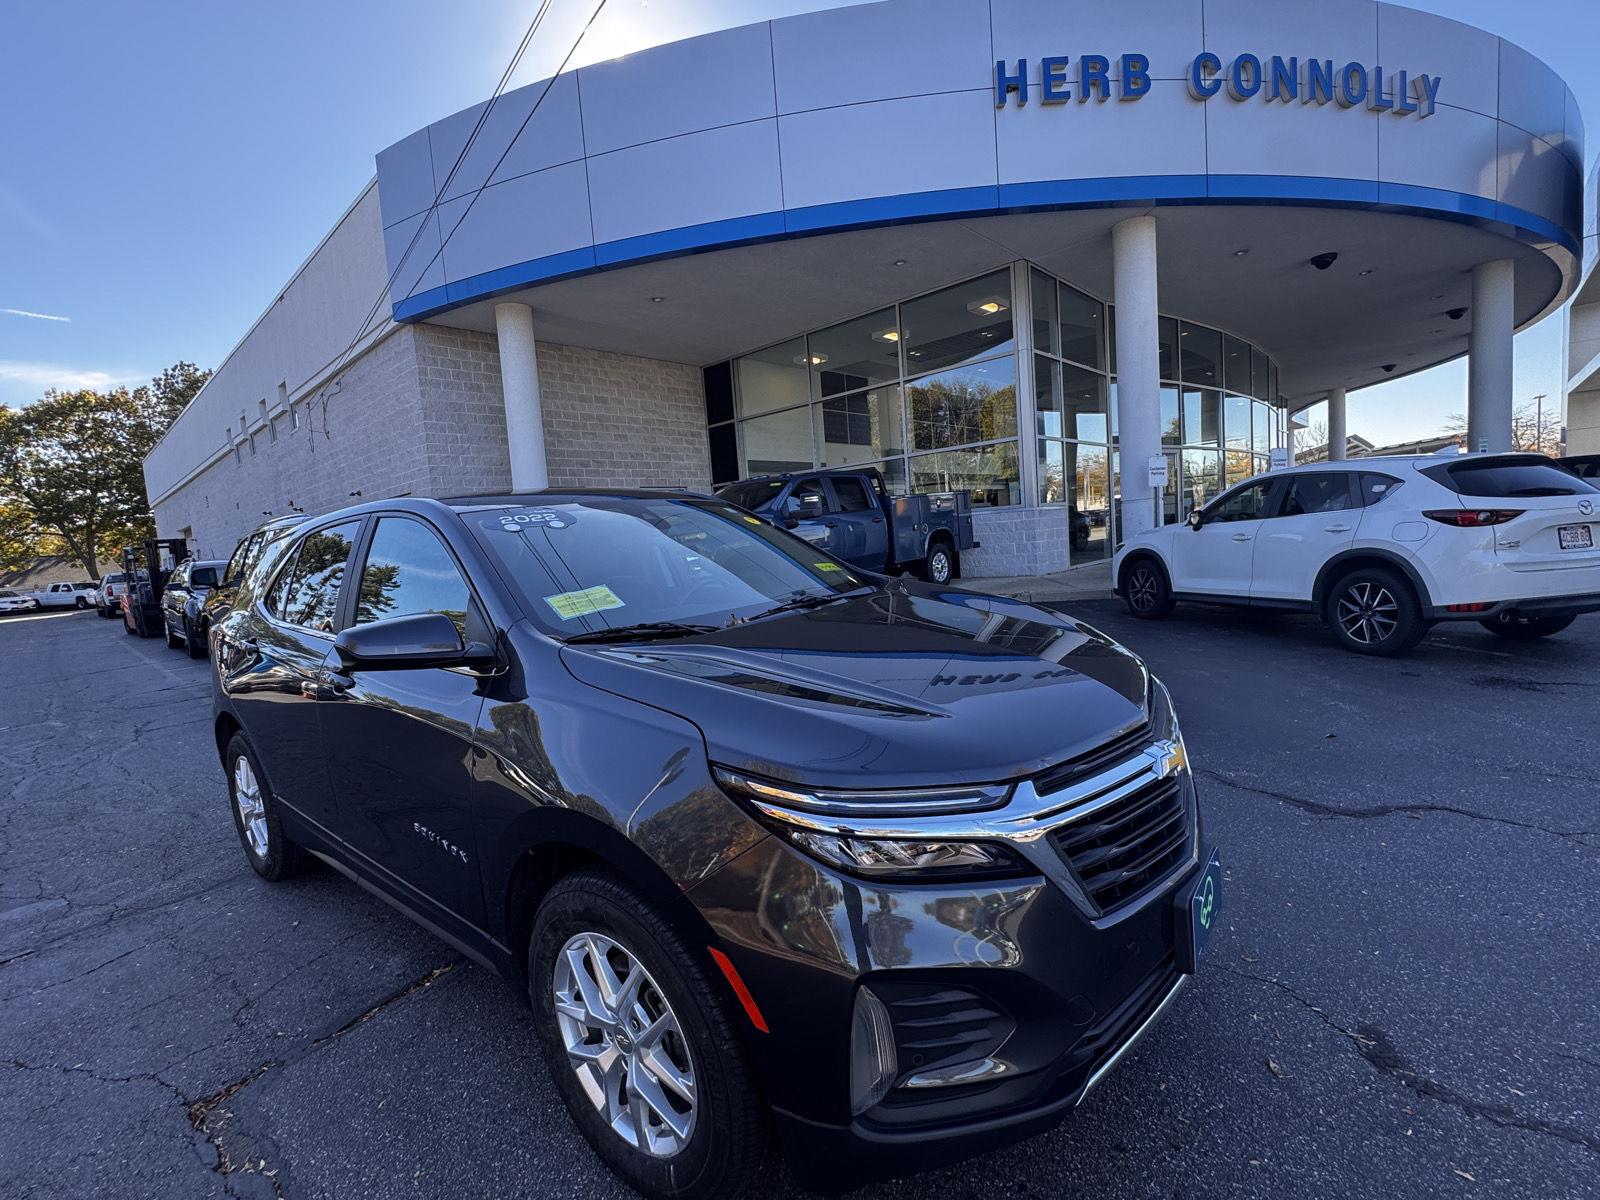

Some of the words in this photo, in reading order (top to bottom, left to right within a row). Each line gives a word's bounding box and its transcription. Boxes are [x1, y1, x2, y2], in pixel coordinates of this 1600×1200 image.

[995, 53, 1151, 109] HERB
[1187, 52, 1442, 119] CONNOLLY
[499, 513, 559, 524] 2022
[413, 822, 469, 863] EQUINOX
